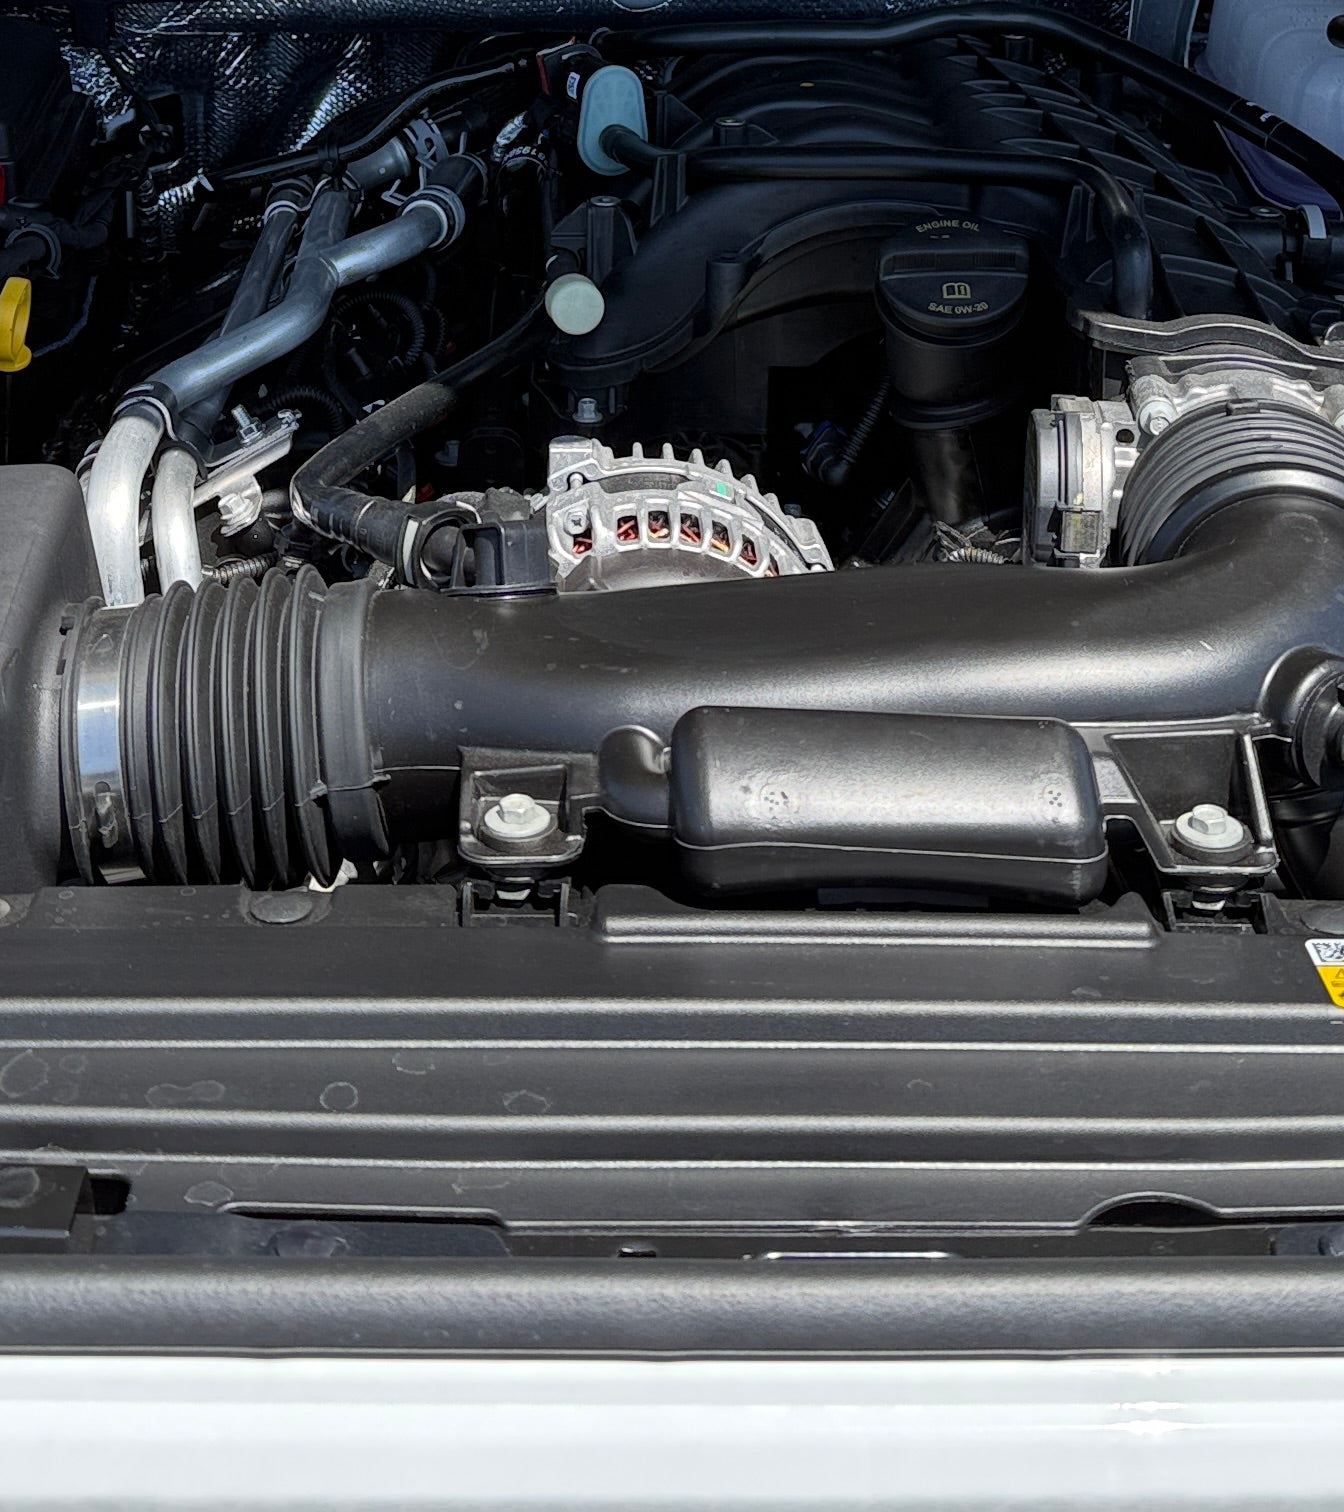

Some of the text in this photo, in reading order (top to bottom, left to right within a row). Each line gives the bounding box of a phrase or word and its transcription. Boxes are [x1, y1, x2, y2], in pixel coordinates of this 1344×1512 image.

[916, 219, 980, 233] ENGINE OIL
[928, 301, 988, 314] SAE 0W-20
